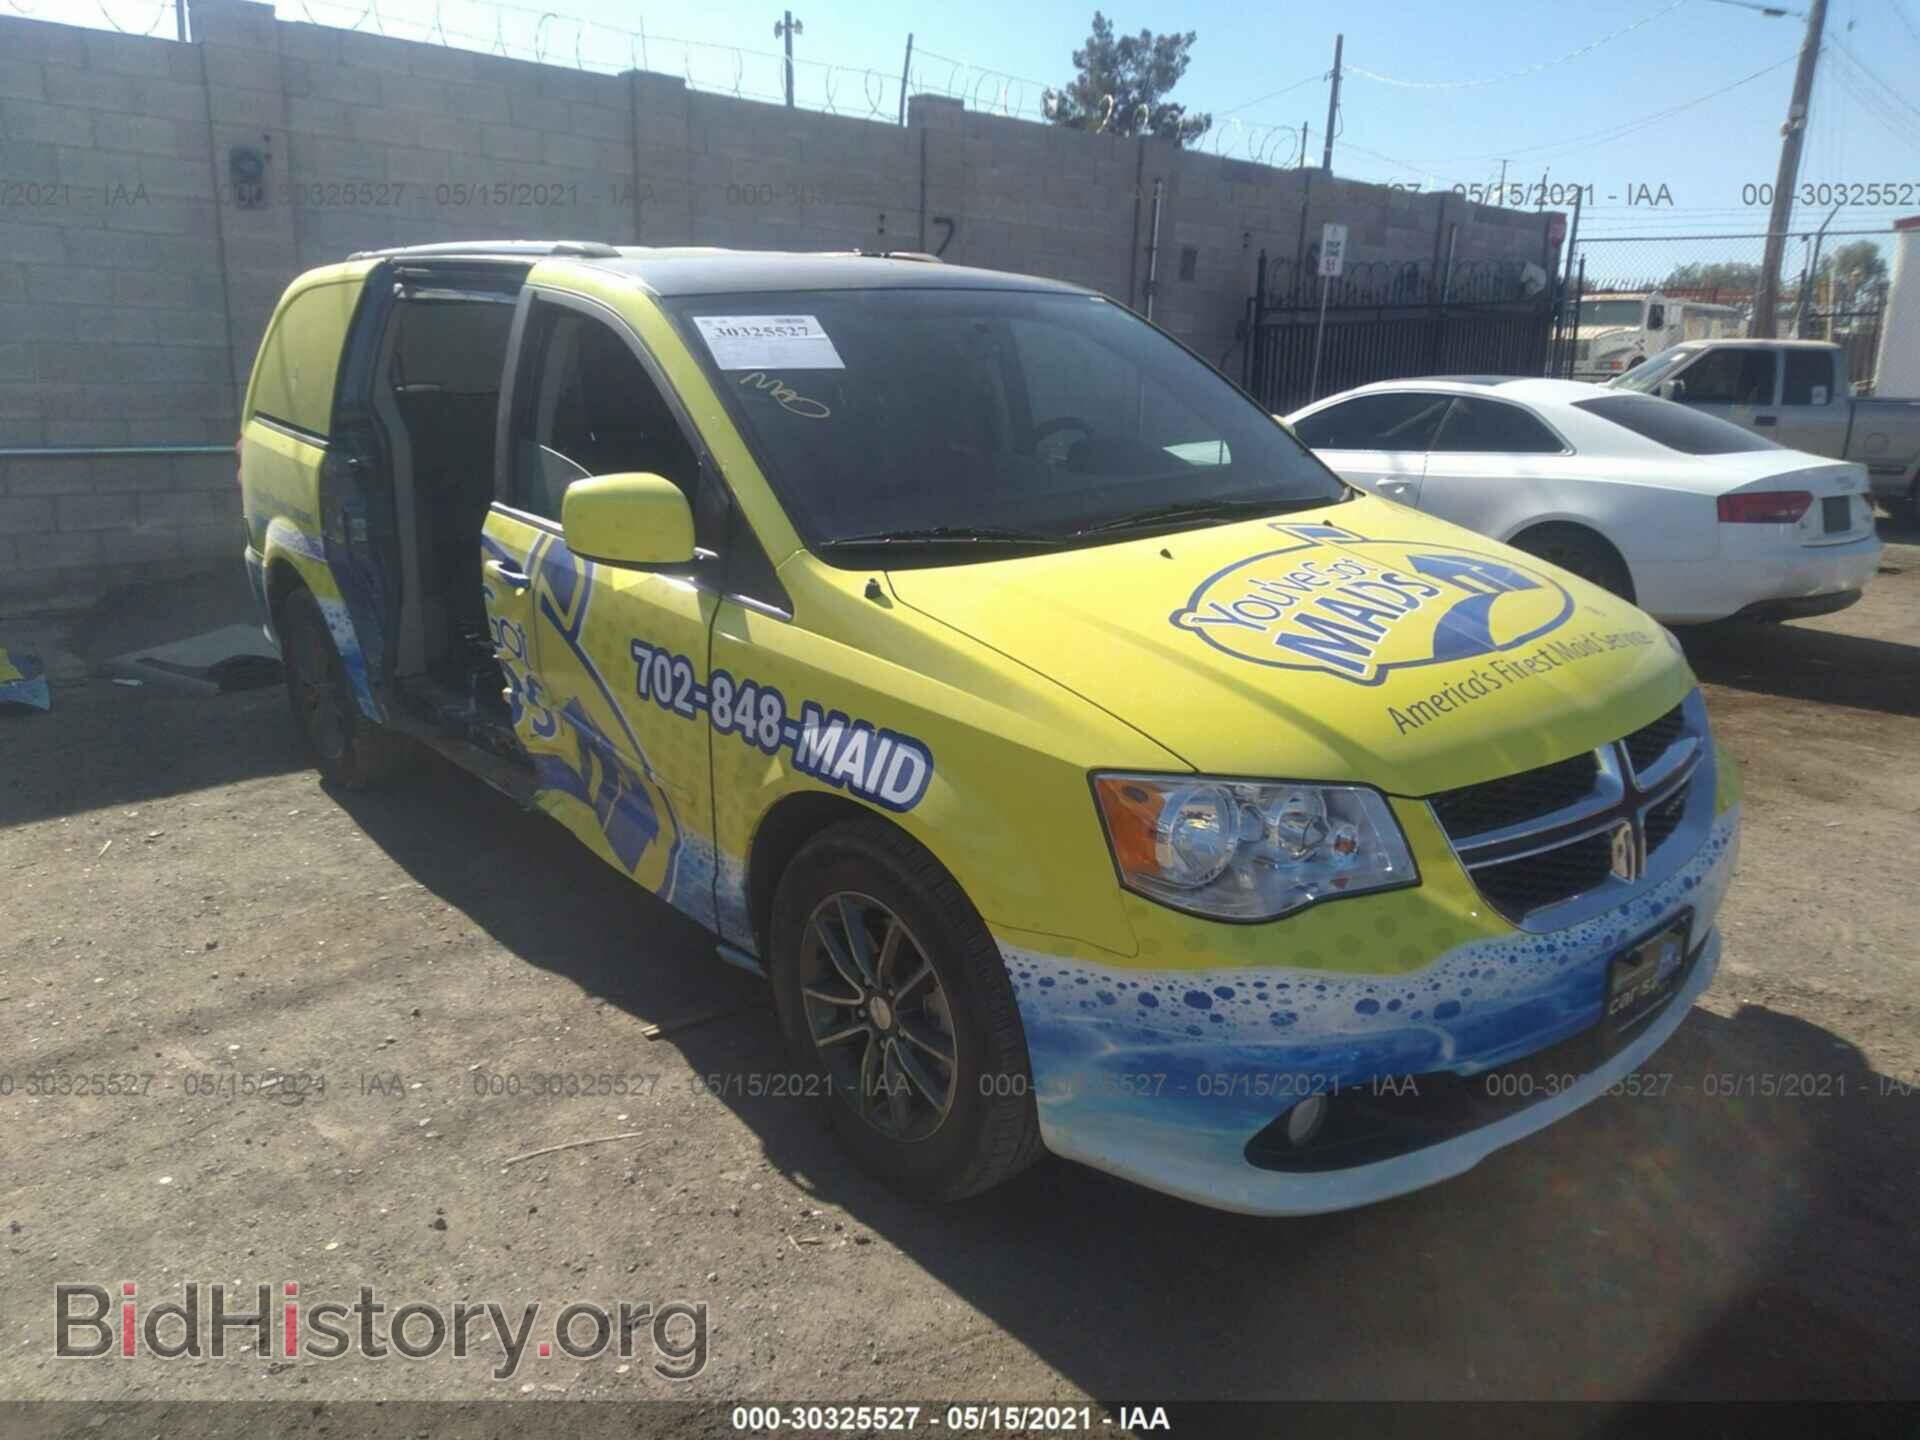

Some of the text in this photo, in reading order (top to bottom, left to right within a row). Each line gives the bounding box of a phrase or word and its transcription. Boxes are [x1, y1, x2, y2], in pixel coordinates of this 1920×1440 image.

[713, 326, 809, 338] 30325527
[1274, 572, 1441, 676] MAIDS
[631, 639, 934, 813] 702-848-MAID
[1387, 670, 1503, 736] America's
